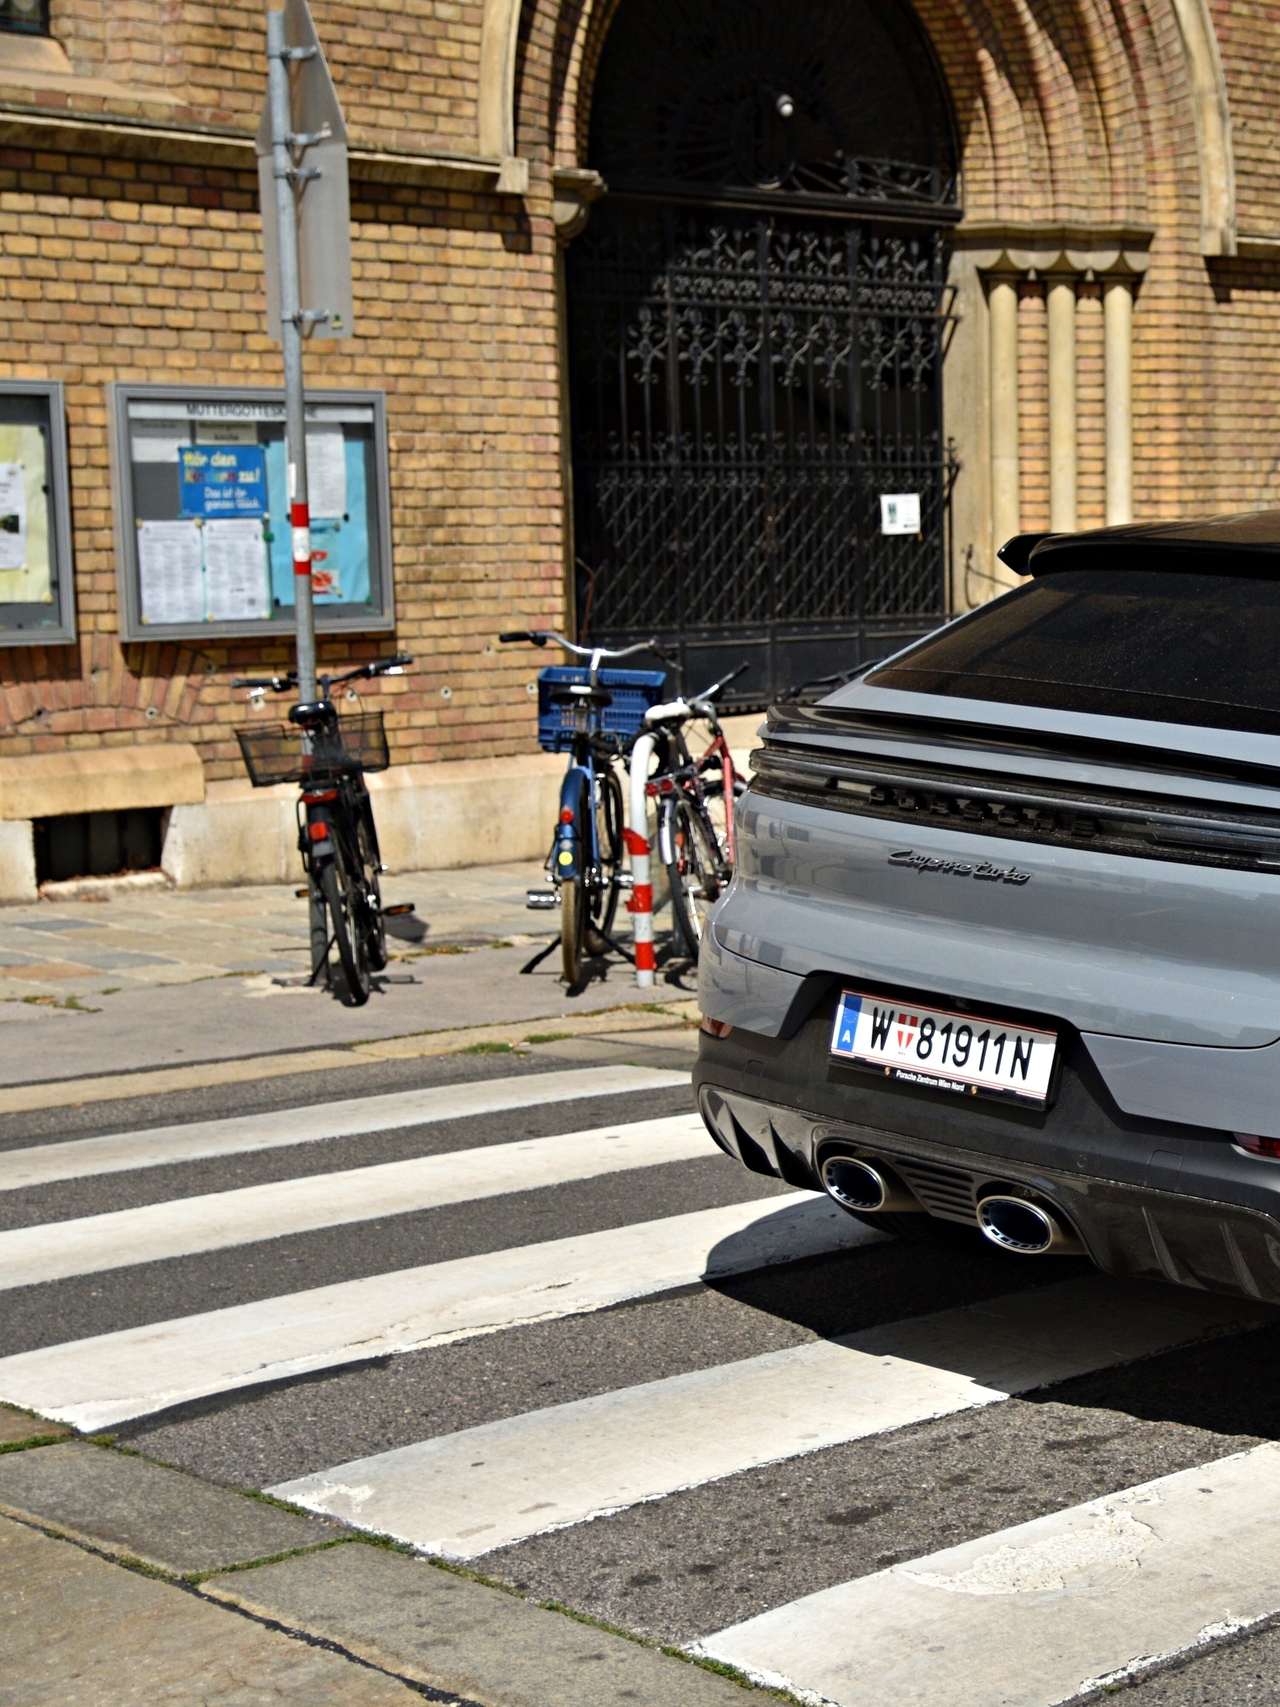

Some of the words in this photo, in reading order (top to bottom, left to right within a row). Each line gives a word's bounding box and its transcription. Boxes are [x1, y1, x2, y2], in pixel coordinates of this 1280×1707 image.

[888, 849, 972, 874] Cayenne
[841, 1030, 851, 1043] A
[870, 1006, 895, 1052] W
[916, 1017, 1035, 1081] 81911N
[896, 1070, 916, 1082] Porsche
[916, 1074, 938, 1086] Zentrum
[938, 1079, 951, 1089] Wien
[951, 1081, 965, 1092] Nord
